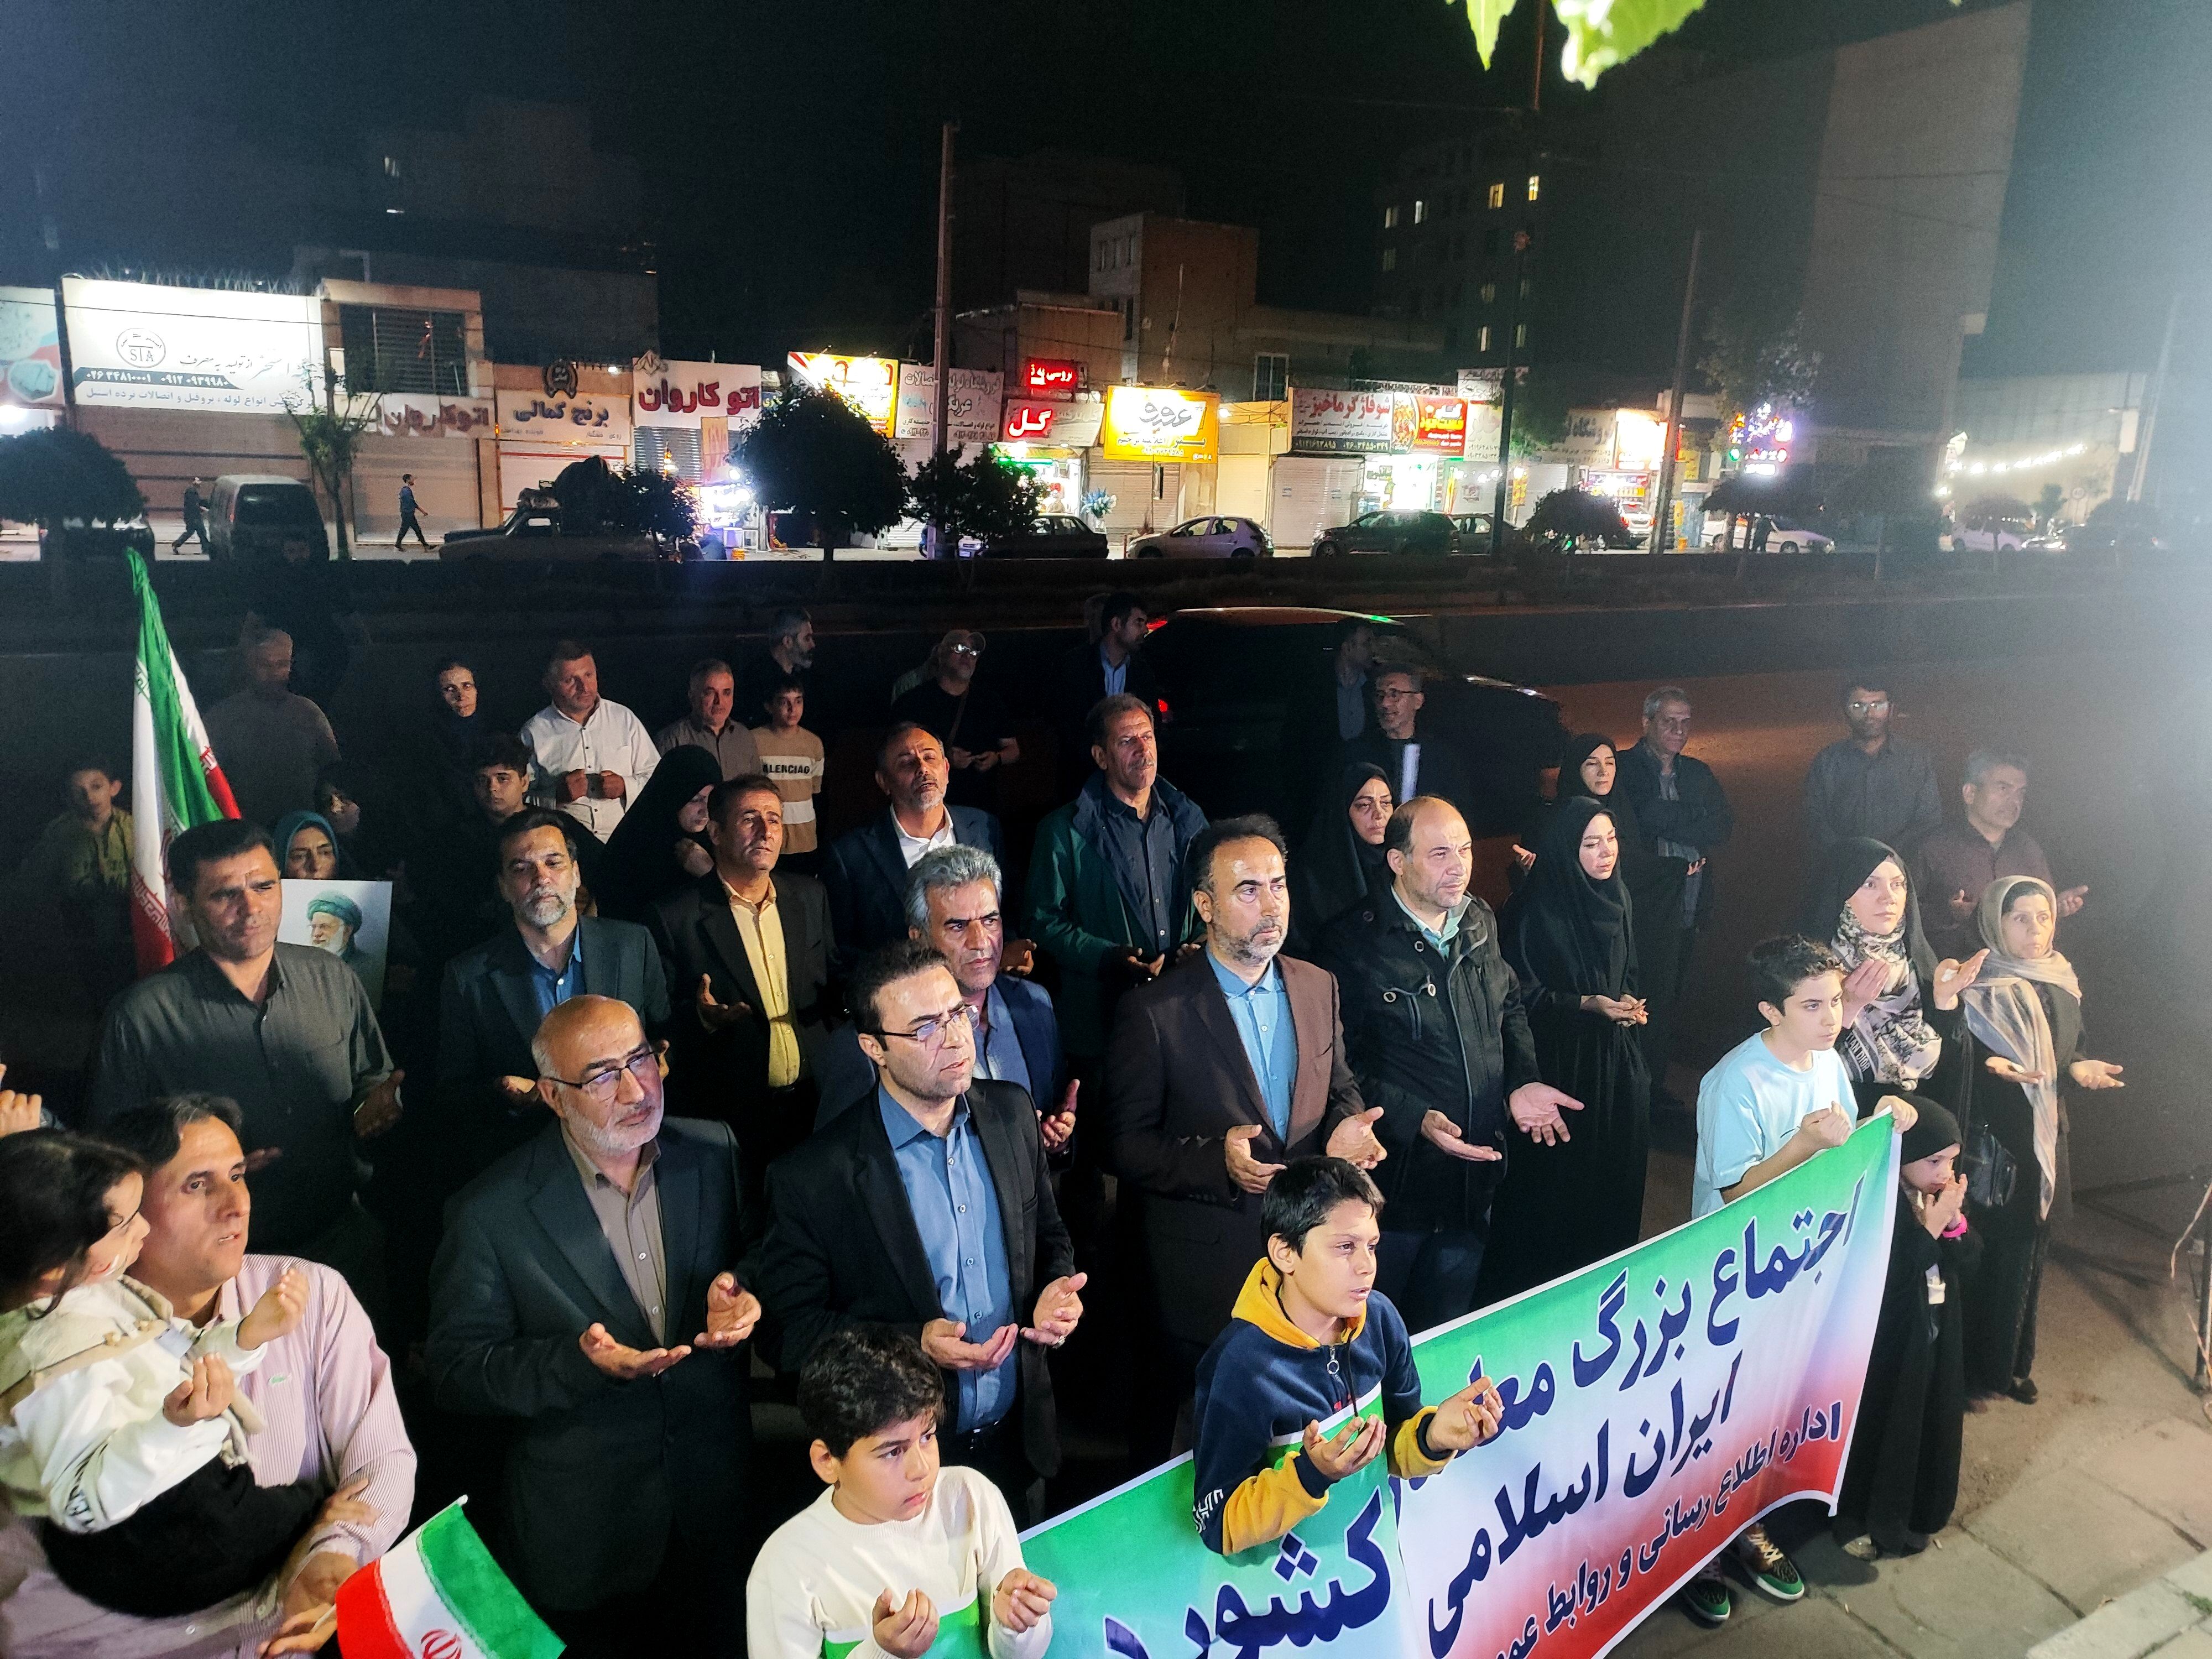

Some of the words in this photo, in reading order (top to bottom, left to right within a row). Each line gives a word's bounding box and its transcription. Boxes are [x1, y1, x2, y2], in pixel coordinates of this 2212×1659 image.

[513, 399, 567, 421] کمالی
[571, 400, 609, 427] برنج
[639, 378, 720, 413] کاروان
[726, 387, 760, 415] اتو
[1009, 408, 1051, 437] گل
[1856, 1051, 1870, 1072] DIOR
[1708, 1173, 1866, 1347] اجتماع
[1573, 1267, 1693, 1391] بزرگ
[1624, 1349, 1744, 1498] ایران
[1780, 1401, 1842, 1464] اداره
[1714, 1427, 1778, 1517] اطلاع
[1428, 1418, 1610, 1659] اسلامی
[1637, 1494, 1712, 1574] رسانی
[1544, 1557, 1613, 1636] روابط
[1616, 1546, 1633, 1592] و
